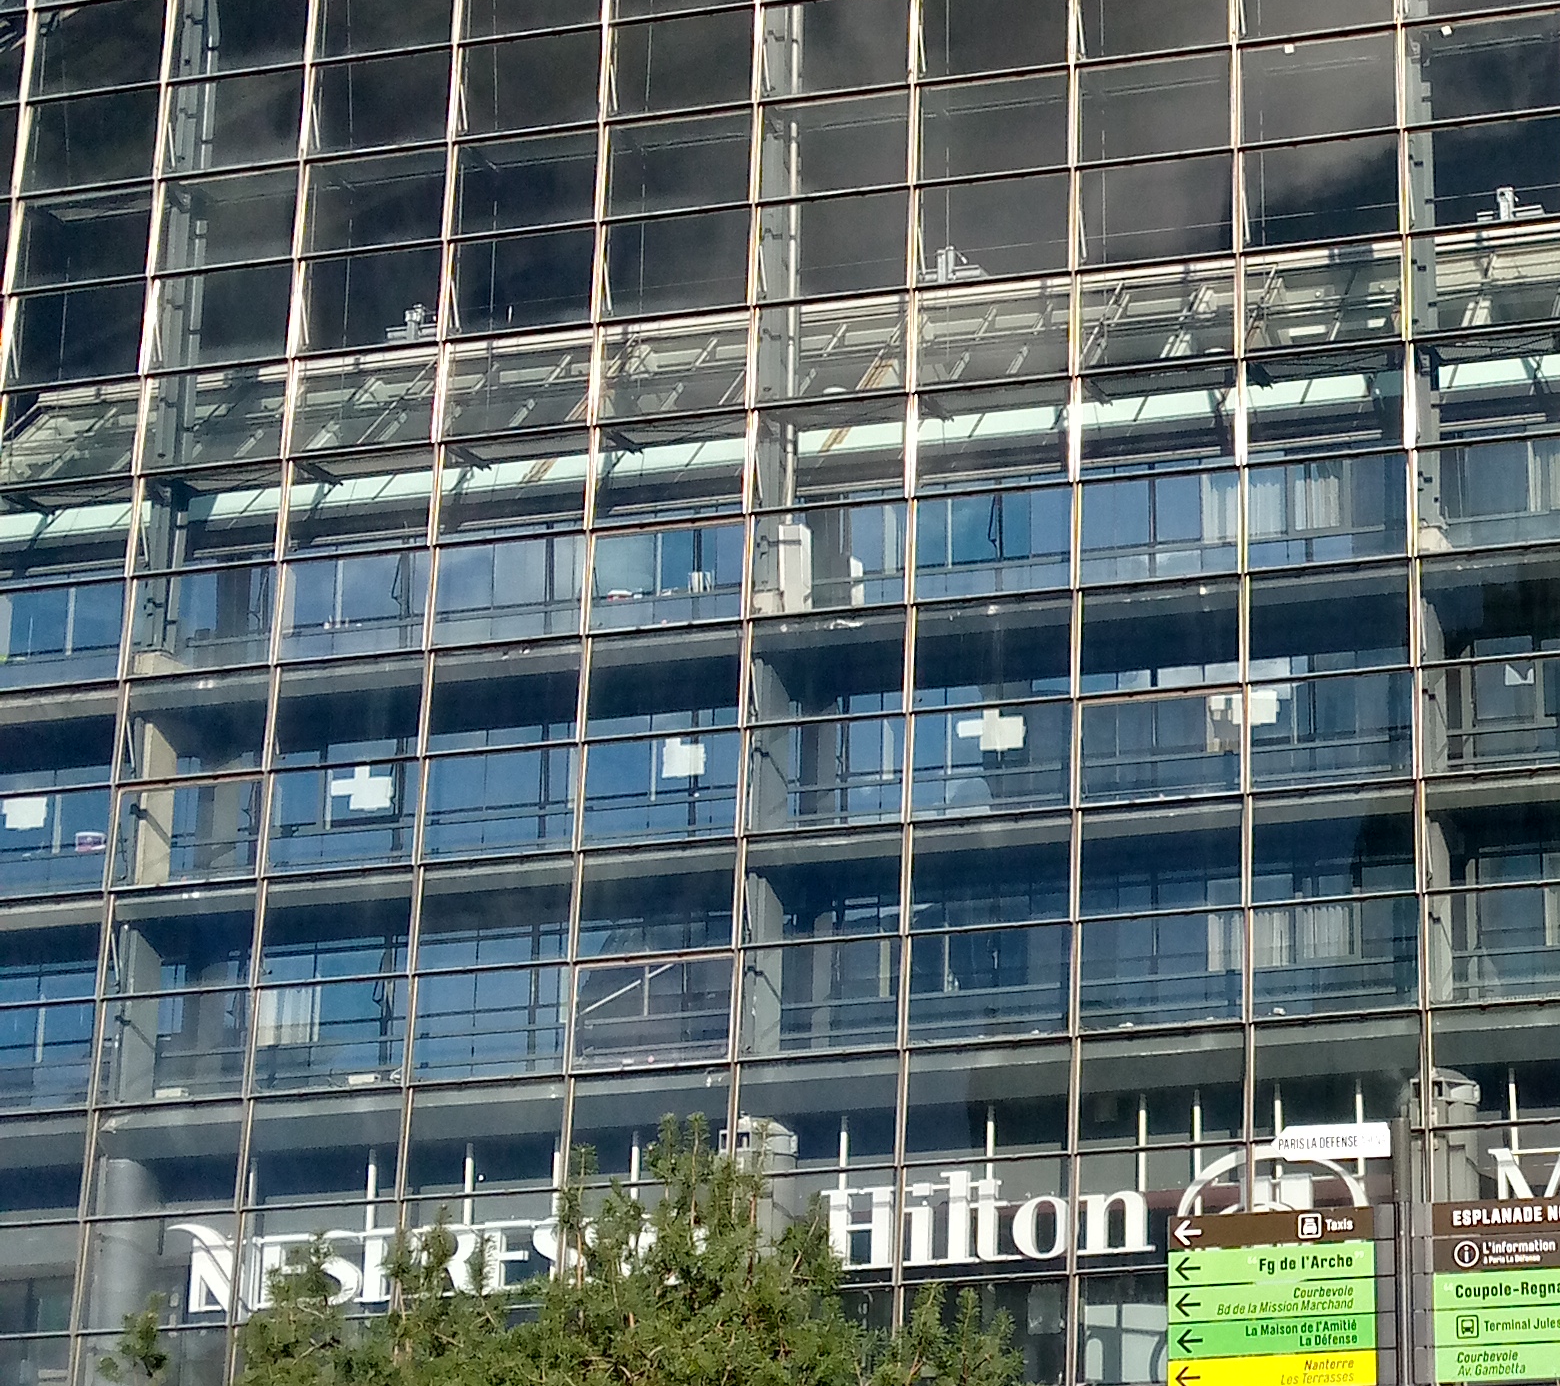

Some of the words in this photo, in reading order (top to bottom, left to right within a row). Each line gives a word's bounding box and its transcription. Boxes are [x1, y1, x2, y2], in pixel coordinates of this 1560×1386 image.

[1278, 1138, 1305, 1151] PARIS
[1306, 1137, 1318, 1150] LA
[820, 1170, 1157, 1271] Hilton
[1452, 1205, 1544, 1227] ESPLANADE
[1325, 1218, 1354, 1232] Taxis
[1482, 1238, 1556, 1255] L'information
[1280, 1258, 1296, 1271] de
[1293, 1285, 1354, 1299] Courbevoie
[1217, 1303, 1231, 1316] Bd
[1233, 1303, 1245, 1315] de
[1247, 1302, 1257, 1314] la
[1259, 1300, 1299, 1313] Mission
[1300, 1298, 1354, 1312] Marchand
[1245, 1325, 1258, 1337] La
[1260, 1322, 1298, 1336] Maison
[1300, 1321, 1314, 1334] de
[1316, 1319, 1357, 1333] l'Amitié
[1484, 1318, 1531, 1333] Terminal
[1299, 1335, 1313, 1347] La
[1314, 1332, 1358, 1346] Défense
[1457, 1350, 1519, 1364] Courbevoie
[1304, 1359, 1354, 1371] Nanterre
[1457, 1365, 1473, 1377] Av.
[1474, 1363, 1526, 1376] Gambetta
[1280, 1374, 1299, 1386] Les
[1302, 1371, 1354, 1385] Terrasses
